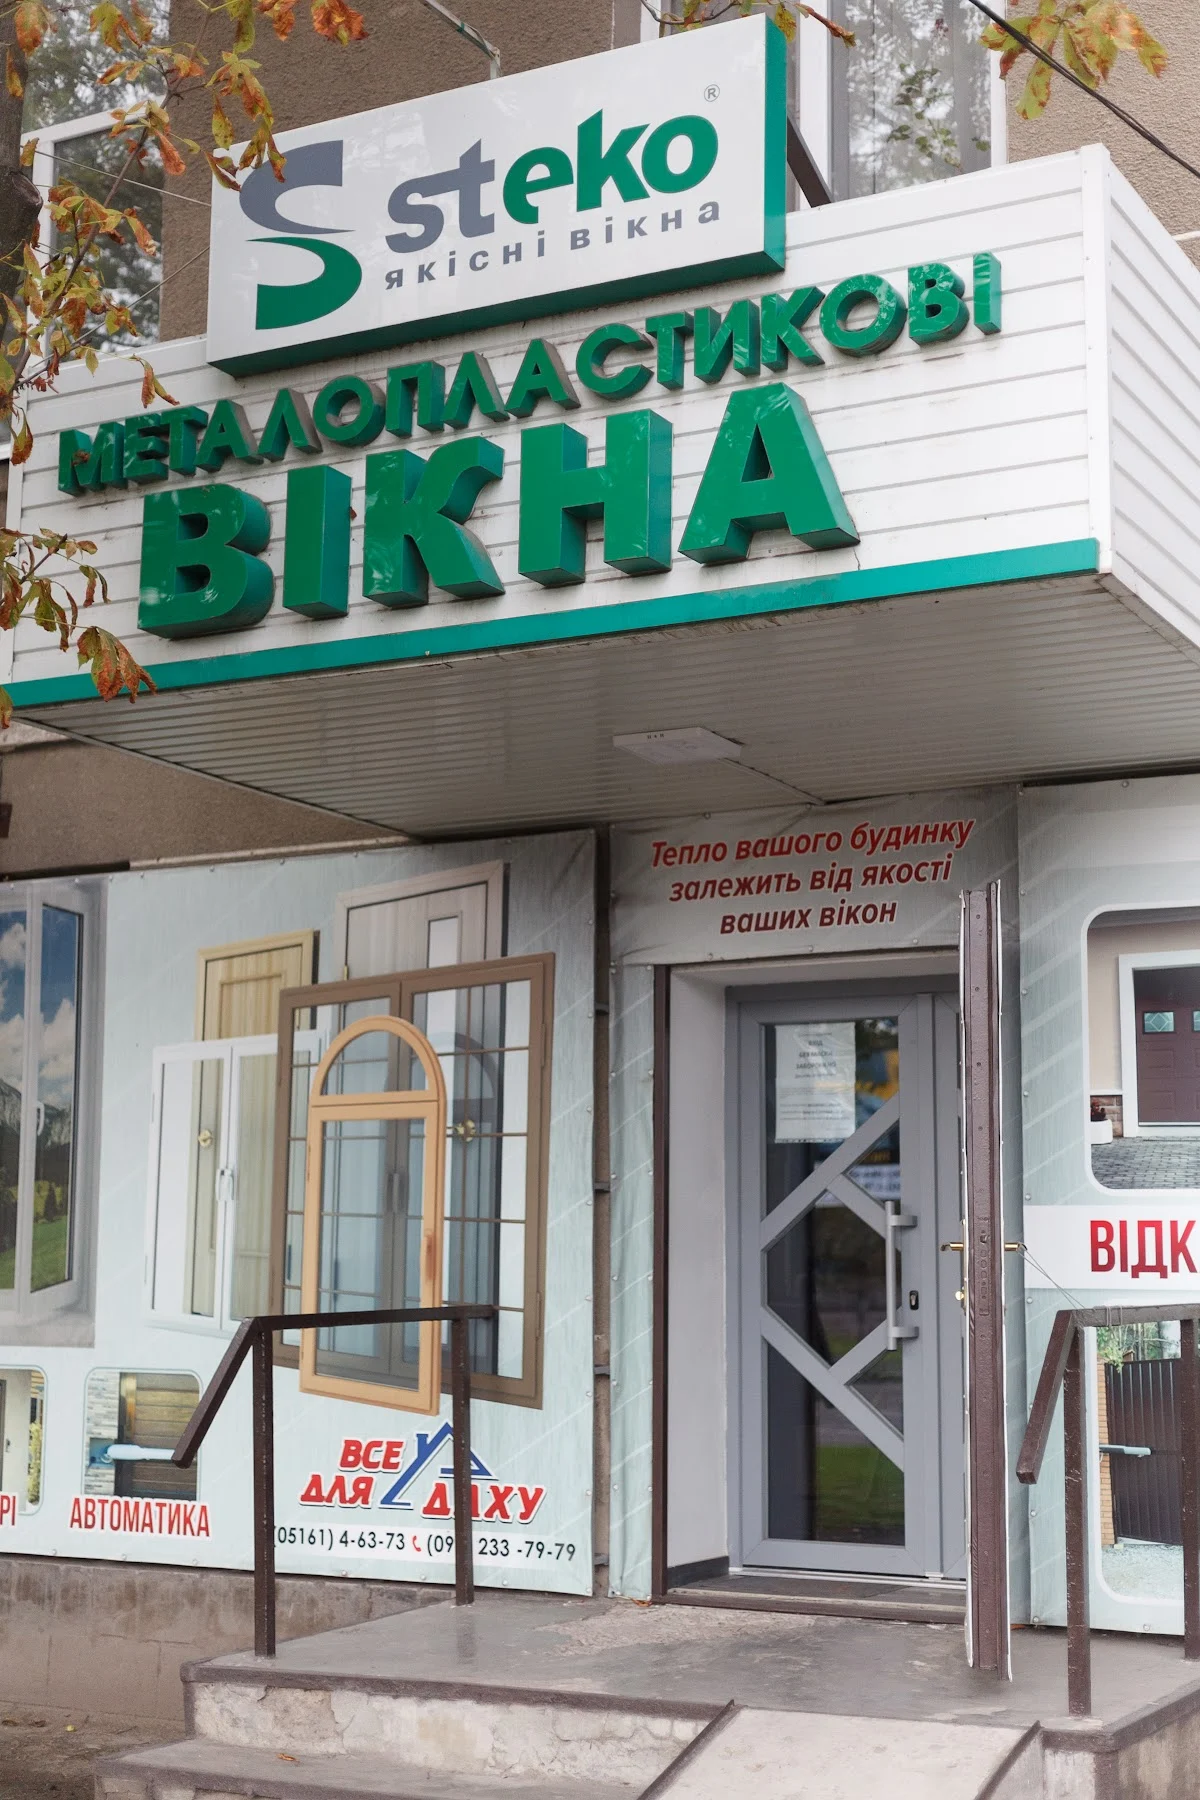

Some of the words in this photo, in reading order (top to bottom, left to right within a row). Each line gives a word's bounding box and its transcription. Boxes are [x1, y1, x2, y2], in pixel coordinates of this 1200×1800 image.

[385, 108, 719, 254] steko
[384, 230, 546, 290] якісні
[570, 201, 720, 251] вікна
[58, 250, 1002, 496] МЕТАЛОПЛАСТИКОВІ
[138, 382, 861, 640] ВІКНА
[651, 841, 727, 868] Тепло
[735, 830, 842, 861] вашого
[850, 818, 976, 856] будинку
[669, 871, 801, 902] залежить
[809, 862, 852, 892] від
[861, 853, 953, 887] якості
[720, 907, 810, 935] ваших
[819, 899, 897, 928] вікон
[340, 1439, 404, 1470] ВСЕ
[300, 1474, 374, 1505] ДЛЯ
[69, 1498, 210, 1537] АВТОМАТИКА
[339, 1530, 406, 1550] 4-63-73
[478, 1537, 510, 1557] 233
